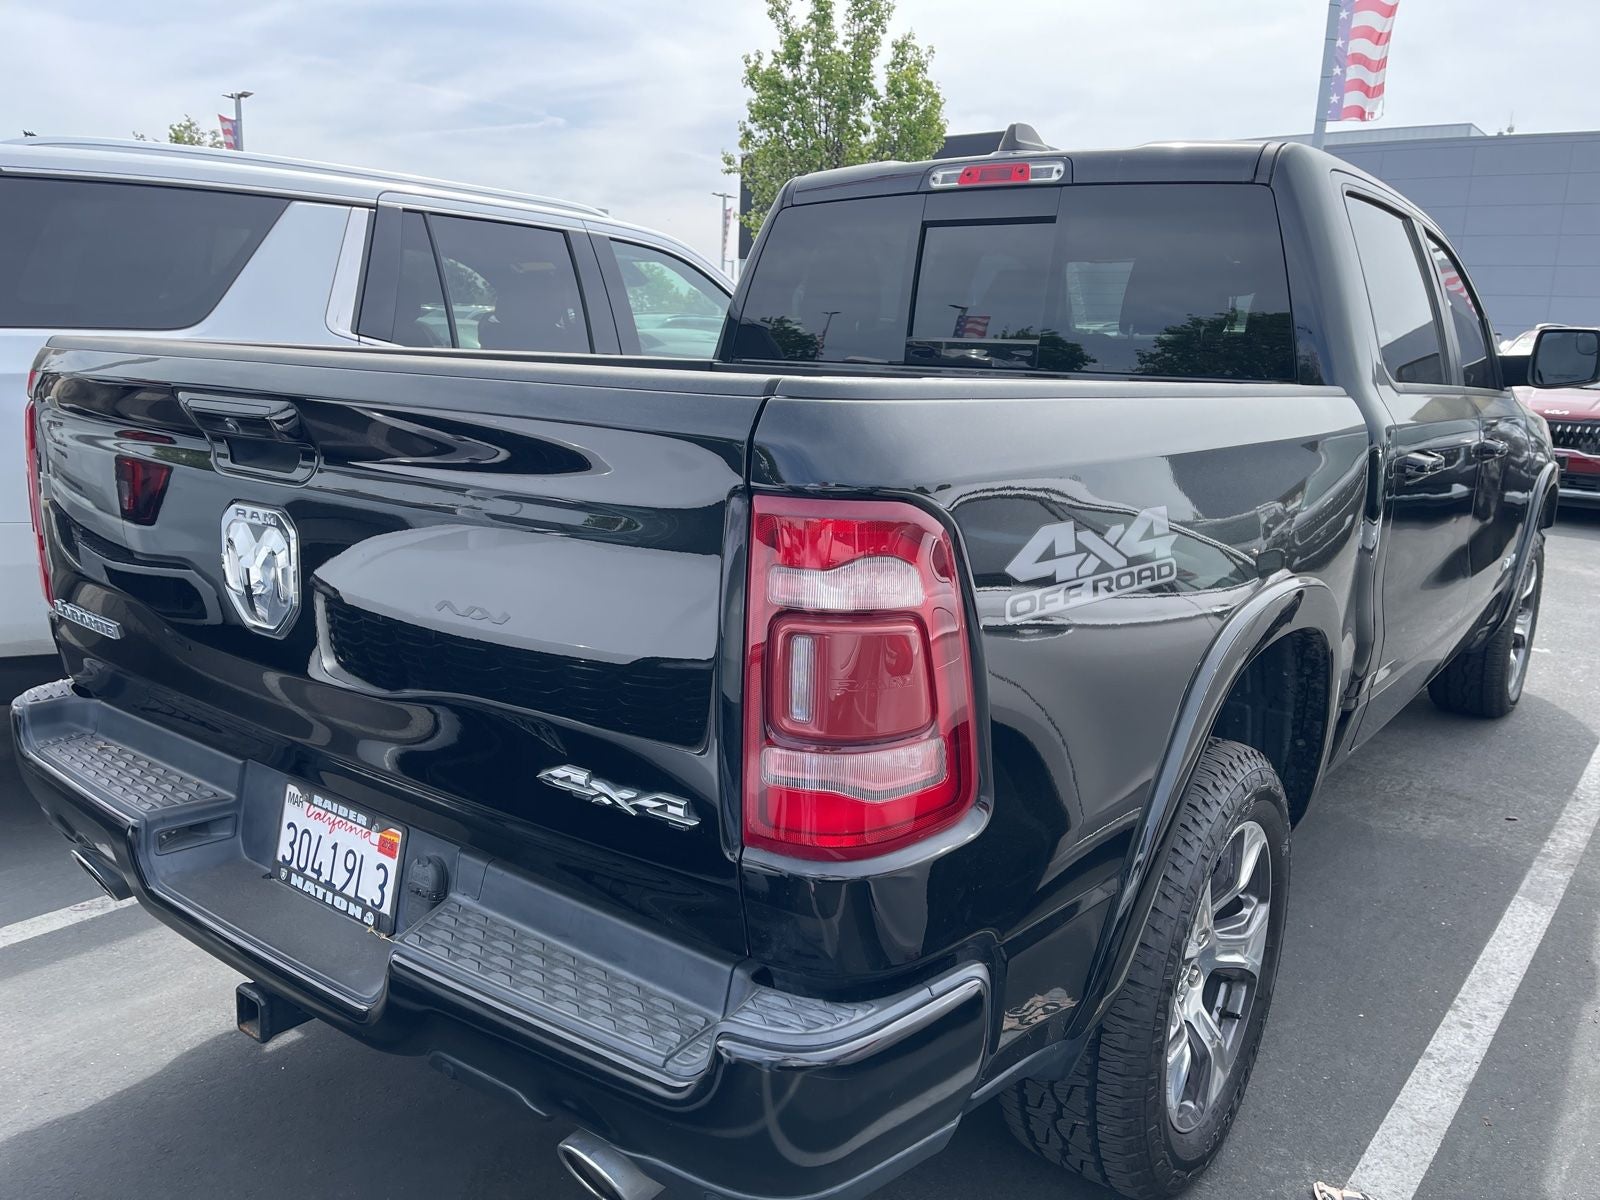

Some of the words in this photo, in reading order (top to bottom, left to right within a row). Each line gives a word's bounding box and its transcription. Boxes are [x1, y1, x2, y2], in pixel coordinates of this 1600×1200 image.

[235, 507, 277, 526] RAM
[1009, 583, 1086, 618] OFF
[1092, 560, 1175, 594] ROAD
[305, 803, 379, 847] California
[313, 795, 368, 826] RAIDER
[281, 821, 389, 911] 30419L3
[290, 872, 363, 920] NATION
